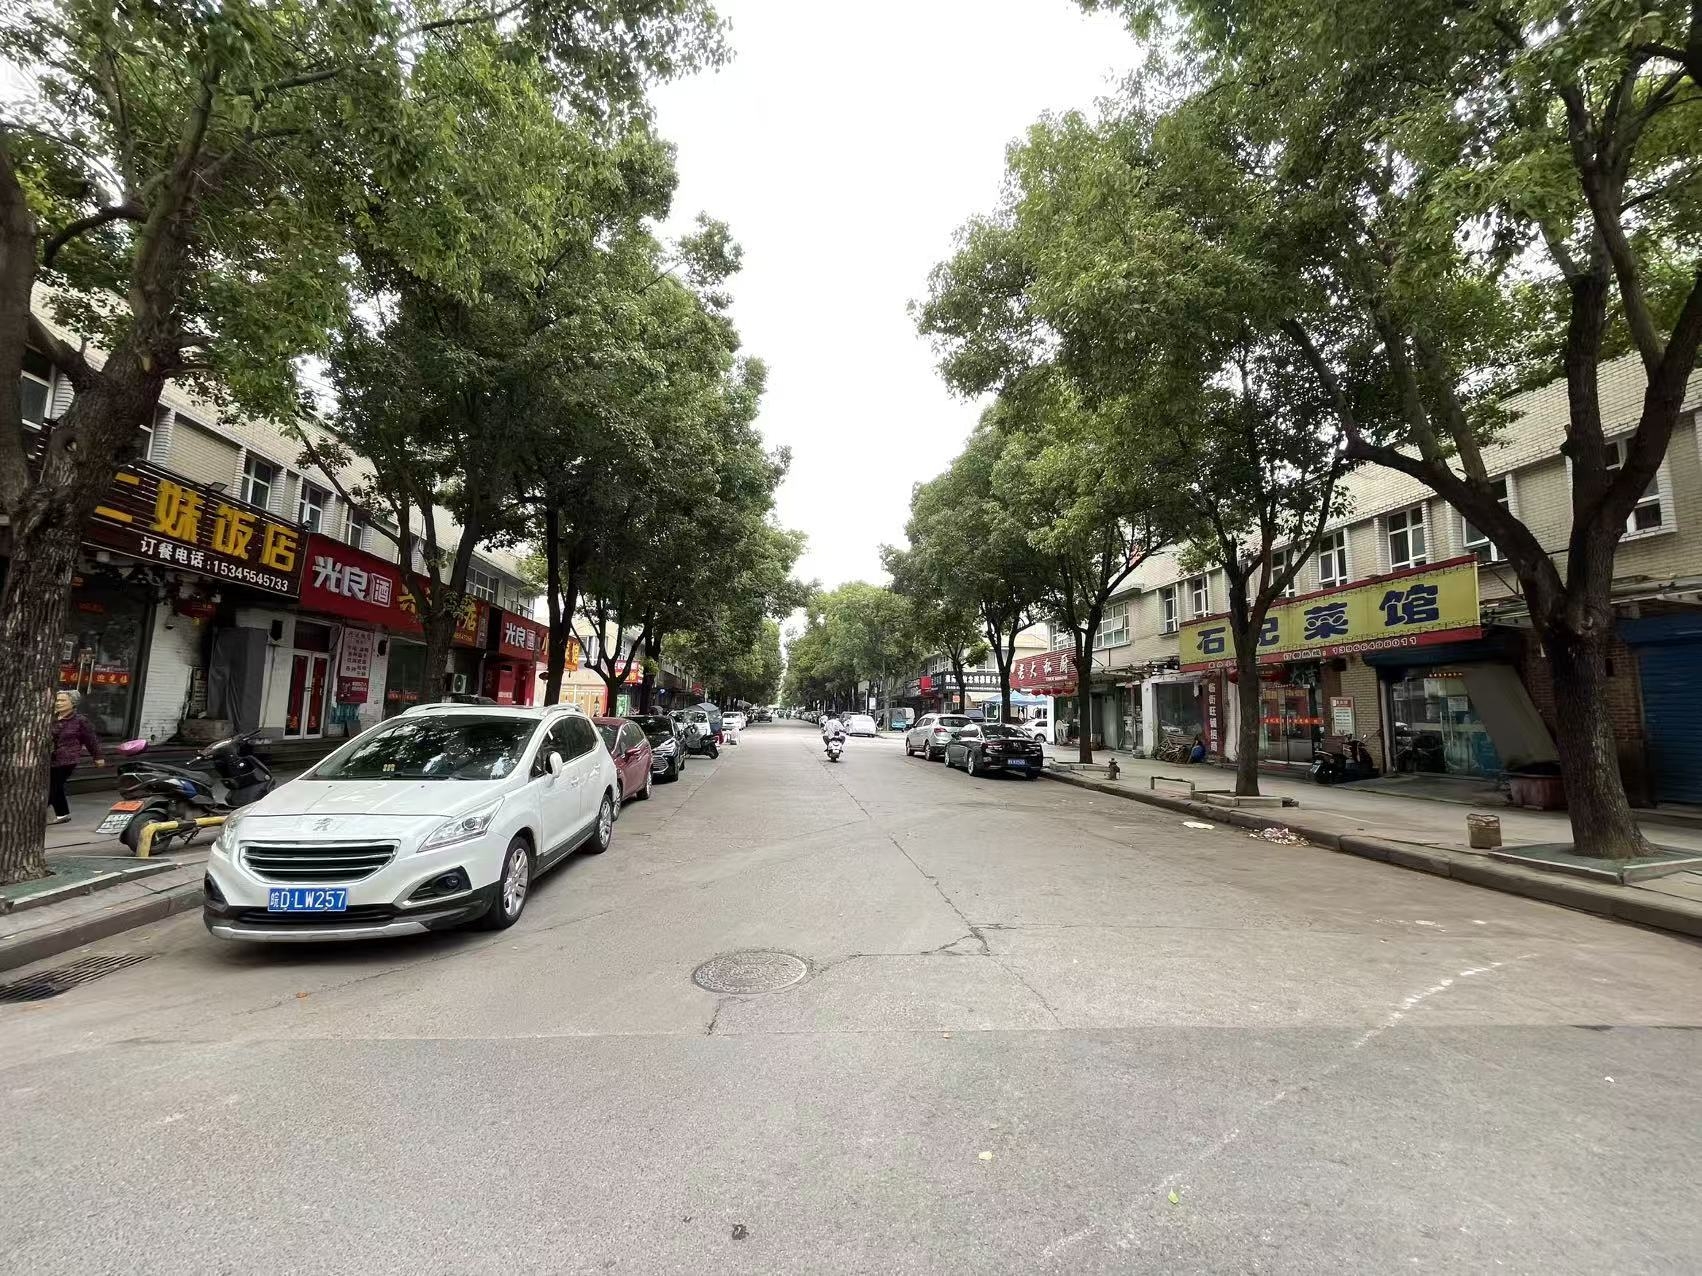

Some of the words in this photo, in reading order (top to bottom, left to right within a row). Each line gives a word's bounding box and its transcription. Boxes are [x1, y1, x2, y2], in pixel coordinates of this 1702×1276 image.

[94, 472, 298, 572] 二妹饭店
[312, 555, 392, 607] 光良酒
